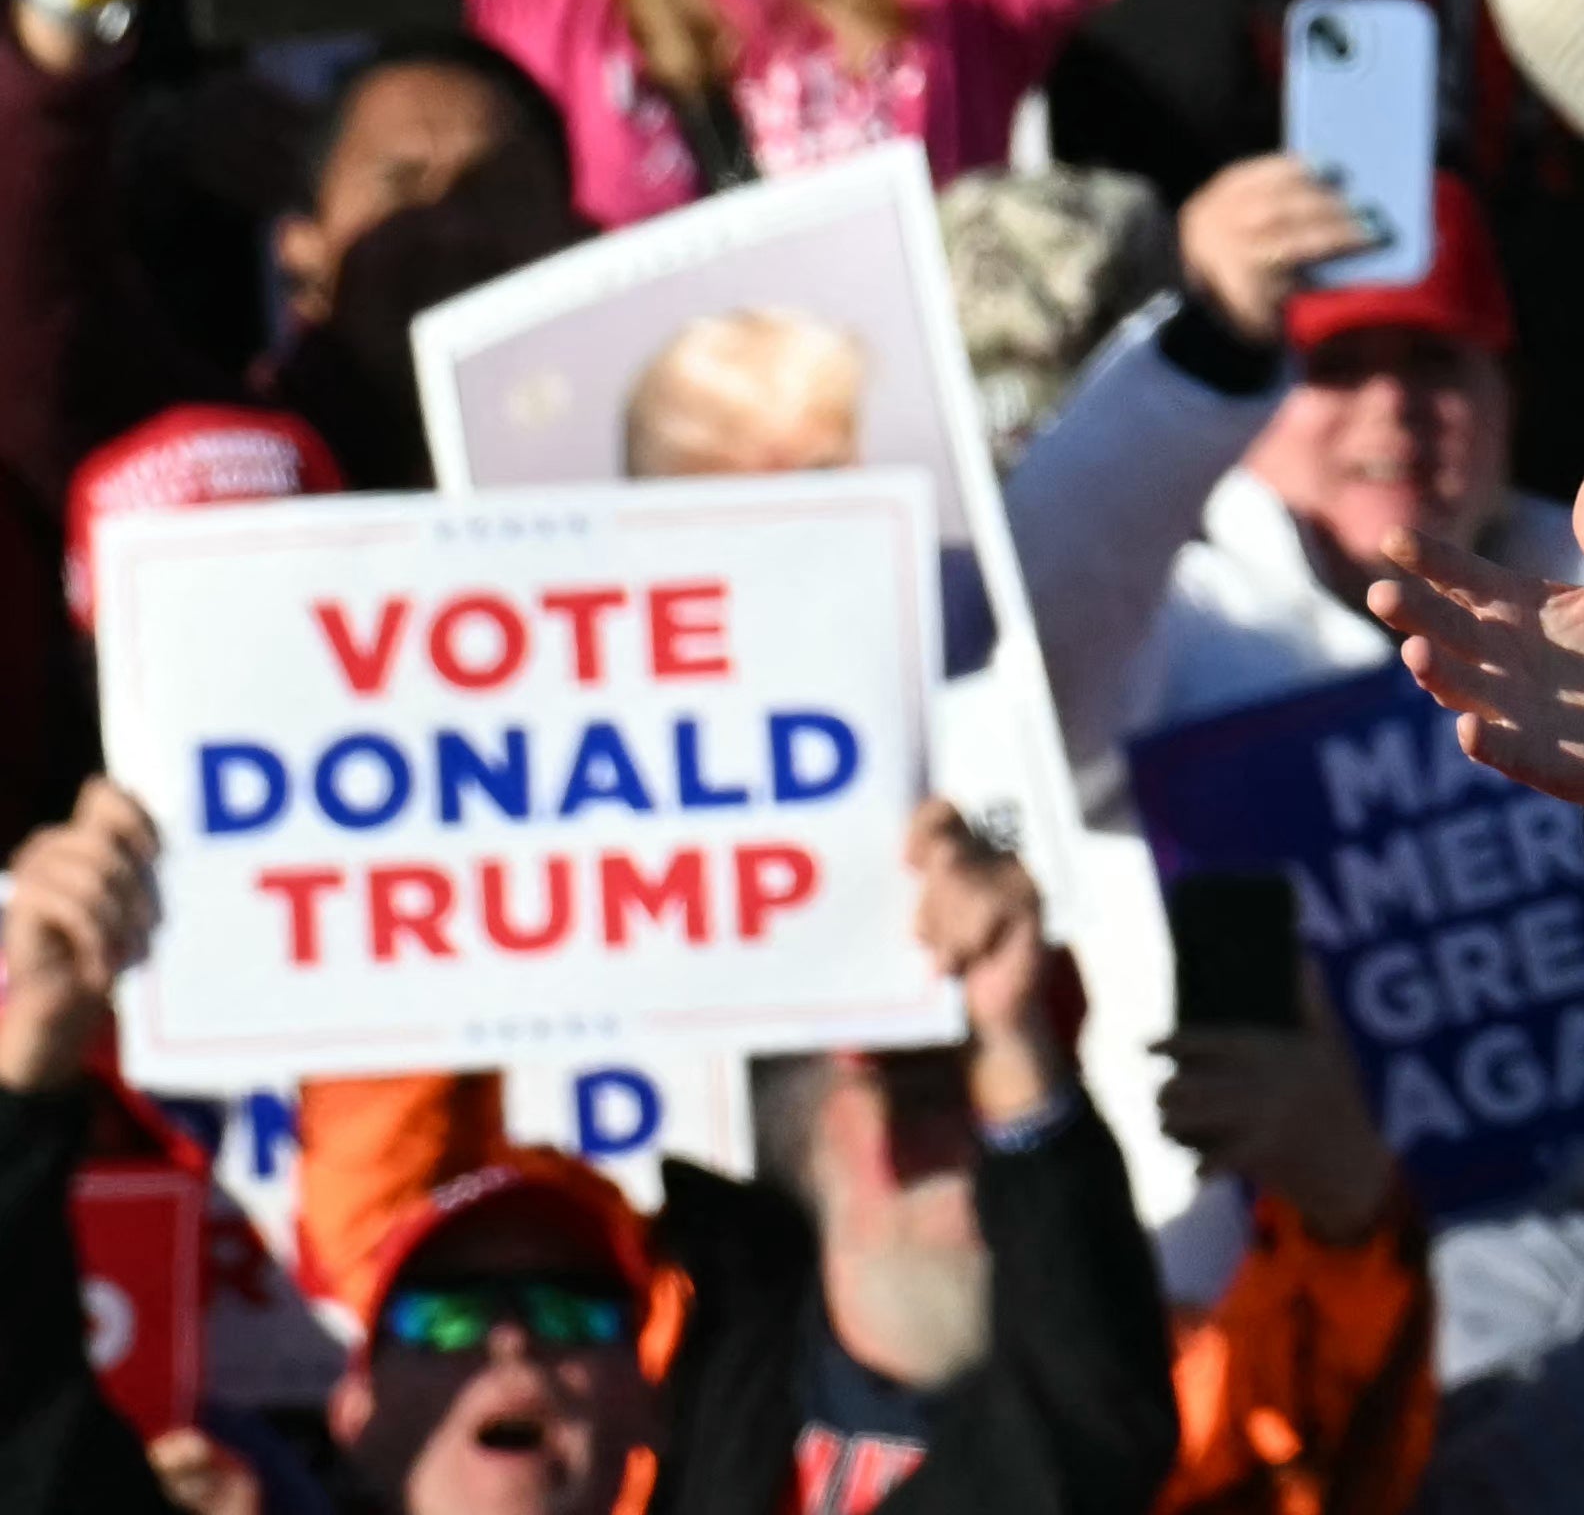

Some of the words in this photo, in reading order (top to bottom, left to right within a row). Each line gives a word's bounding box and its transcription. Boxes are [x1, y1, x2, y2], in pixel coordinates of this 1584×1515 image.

[312, 580, 733, 699] VOTE
[194, 709, 866, 842] DONALD
[1312, 711, 1512, 831] MA
[255, 842, 821, 968] TRUMP
